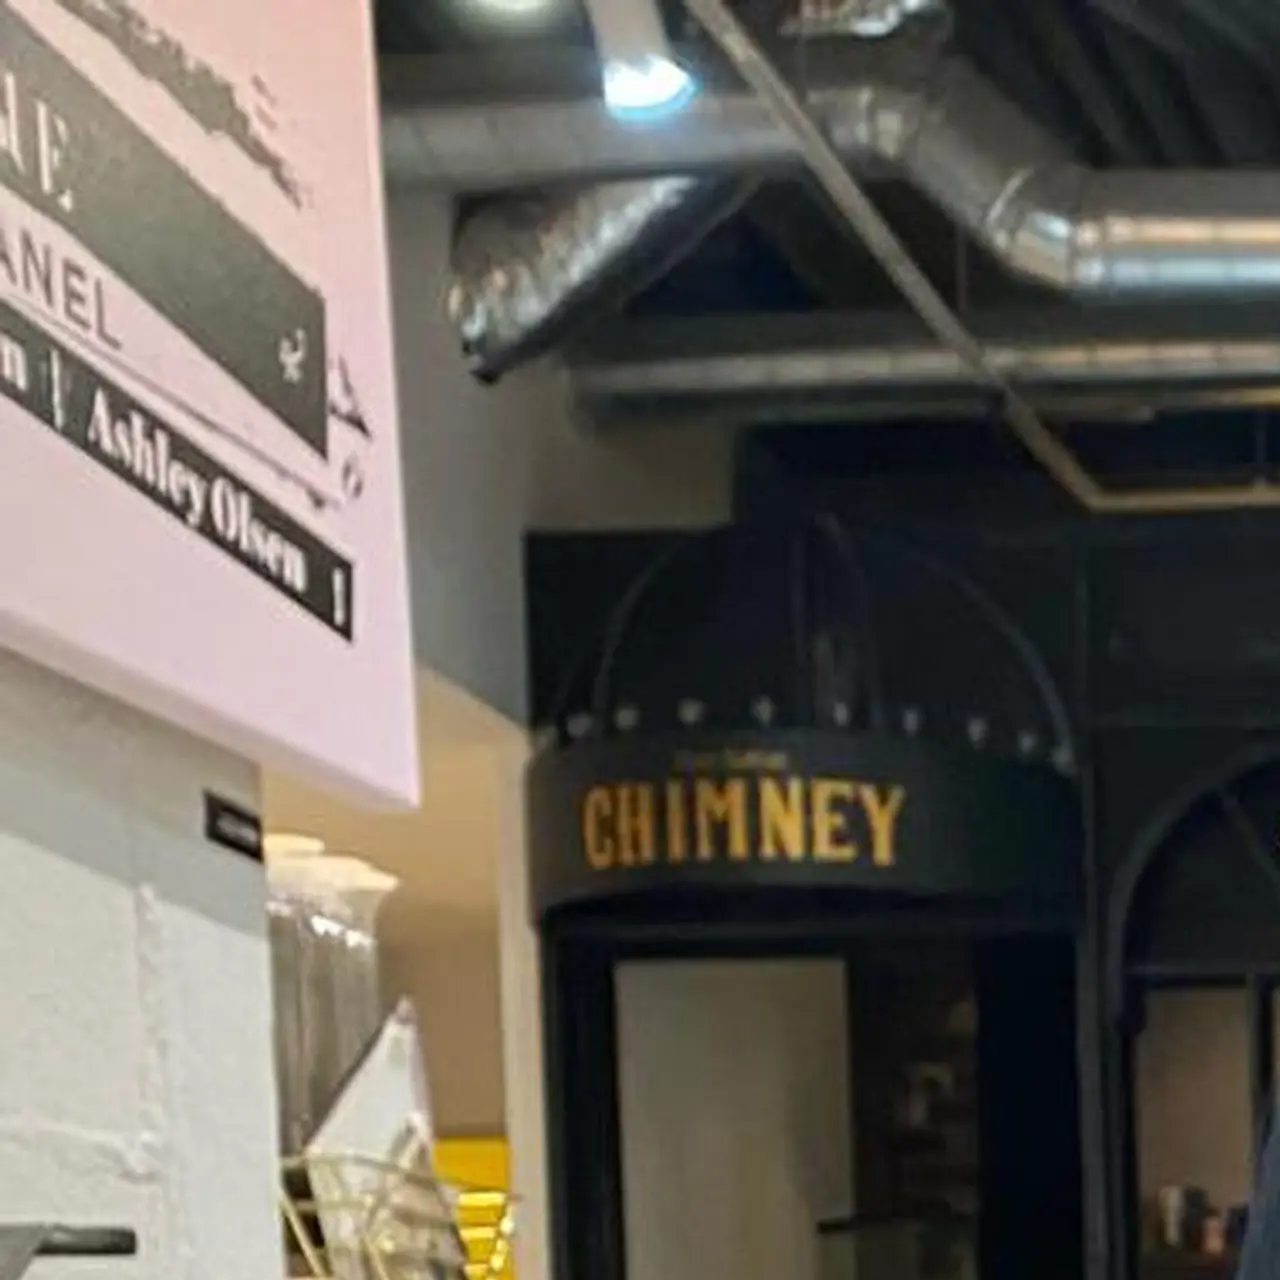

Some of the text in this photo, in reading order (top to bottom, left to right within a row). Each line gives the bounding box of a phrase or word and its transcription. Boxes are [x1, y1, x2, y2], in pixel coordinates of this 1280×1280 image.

[87, 388, 207, 528] Ashley
[210, 477, 308, 593] Olsen
[581, 775, 905, 870] CHIMNEY
